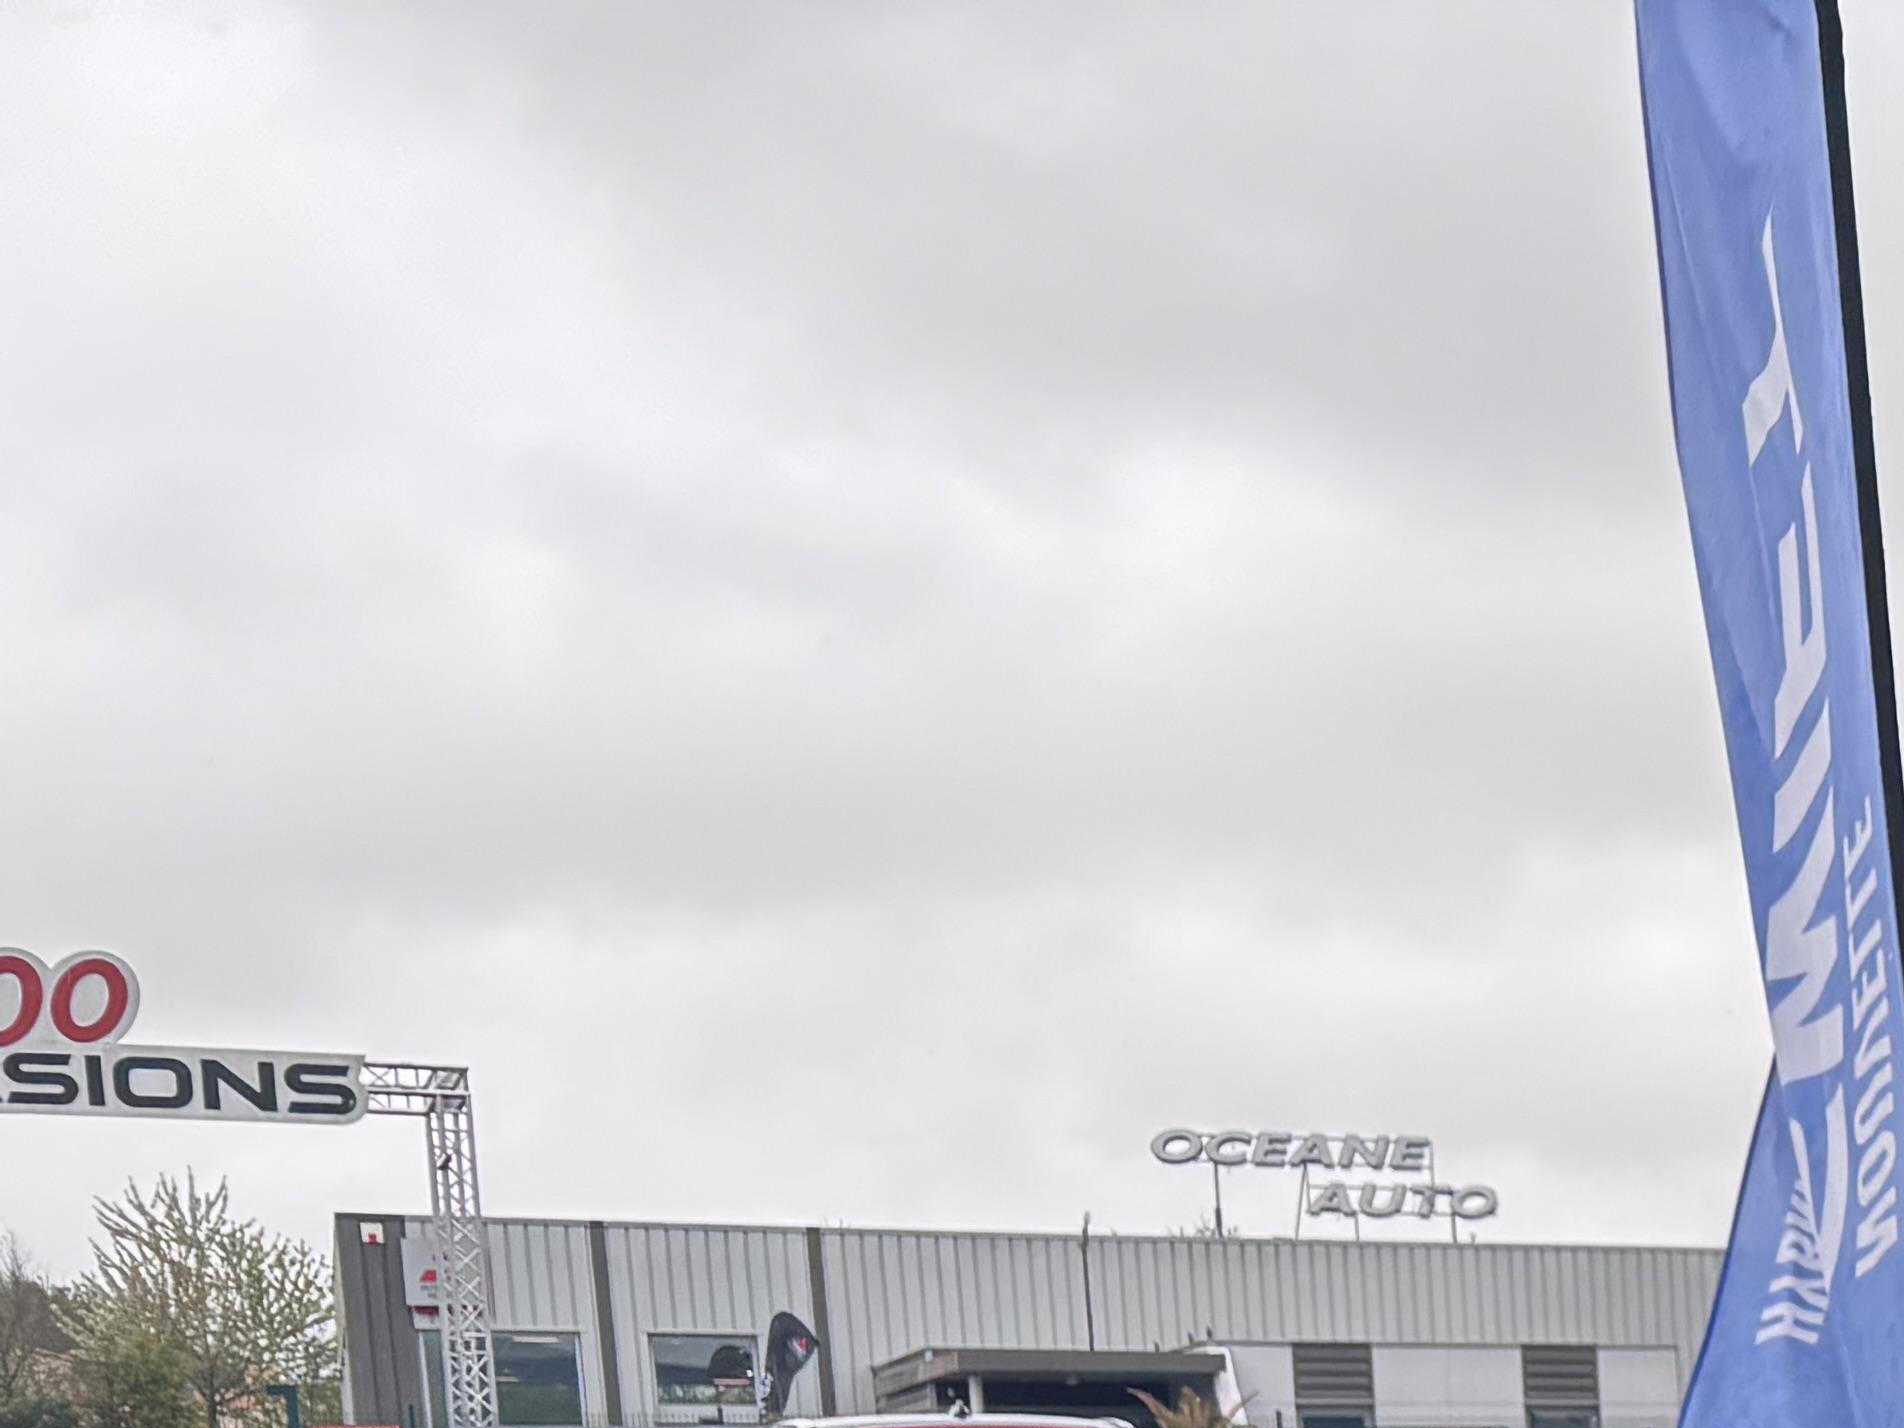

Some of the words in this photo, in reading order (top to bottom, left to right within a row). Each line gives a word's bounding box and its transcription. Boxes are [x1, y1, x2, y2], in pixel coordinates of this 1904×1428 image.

[0, 1052, 358, 1114] SIONS
[1150, 1128, 1433, 1170] OCEANE
[1306, 1182, 1499, 1220] AUTO
